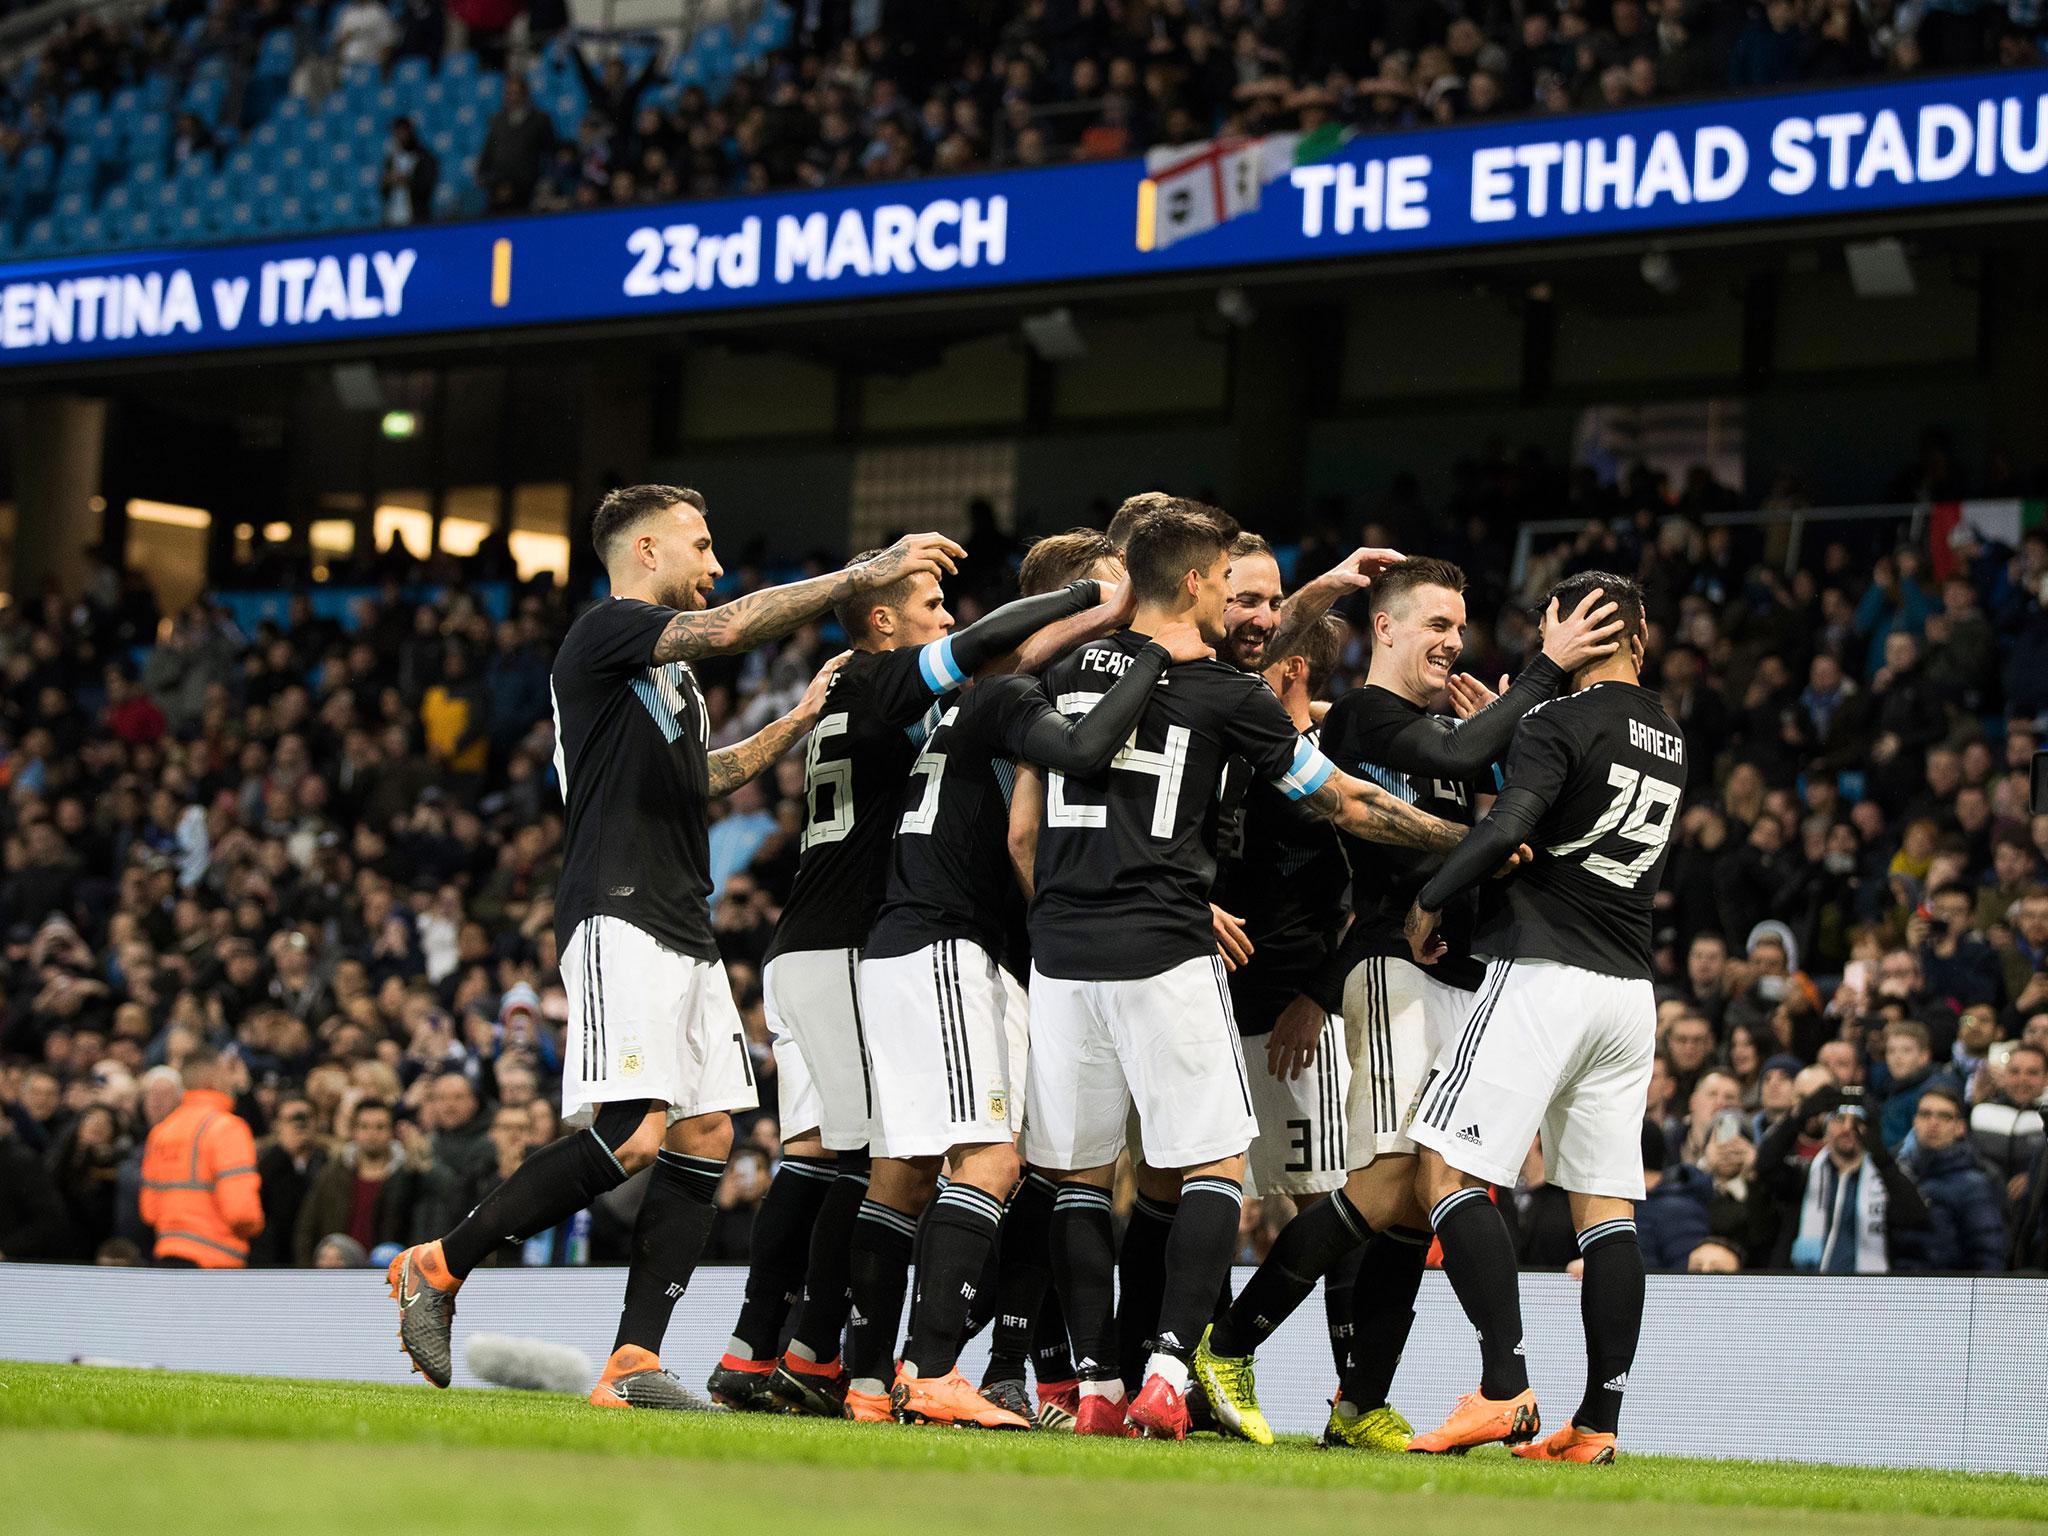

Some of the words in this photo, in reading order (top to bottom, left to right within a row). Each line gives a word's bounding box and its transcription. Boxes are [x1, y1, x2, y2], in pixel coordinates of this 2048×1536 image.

[1290, 155, 1432, 238] THE
[1470, 126, 1750, 222] ETIHAD
[1768, 93, 2048, 195] STADIU
[623, 216, 761, 296] 23rd
[774, 195, 1008, 284] MARCH
[0, 271, 201, 349] ENTINA
[212, 277, 249, 330] v
[259, 249, 416, 326] ITALY
[1629, 718, 1683, 766] BANEGA
[1455, 1131, 1482, 1146] adidas
[1002, 1314, 1028, 1329] AFA
